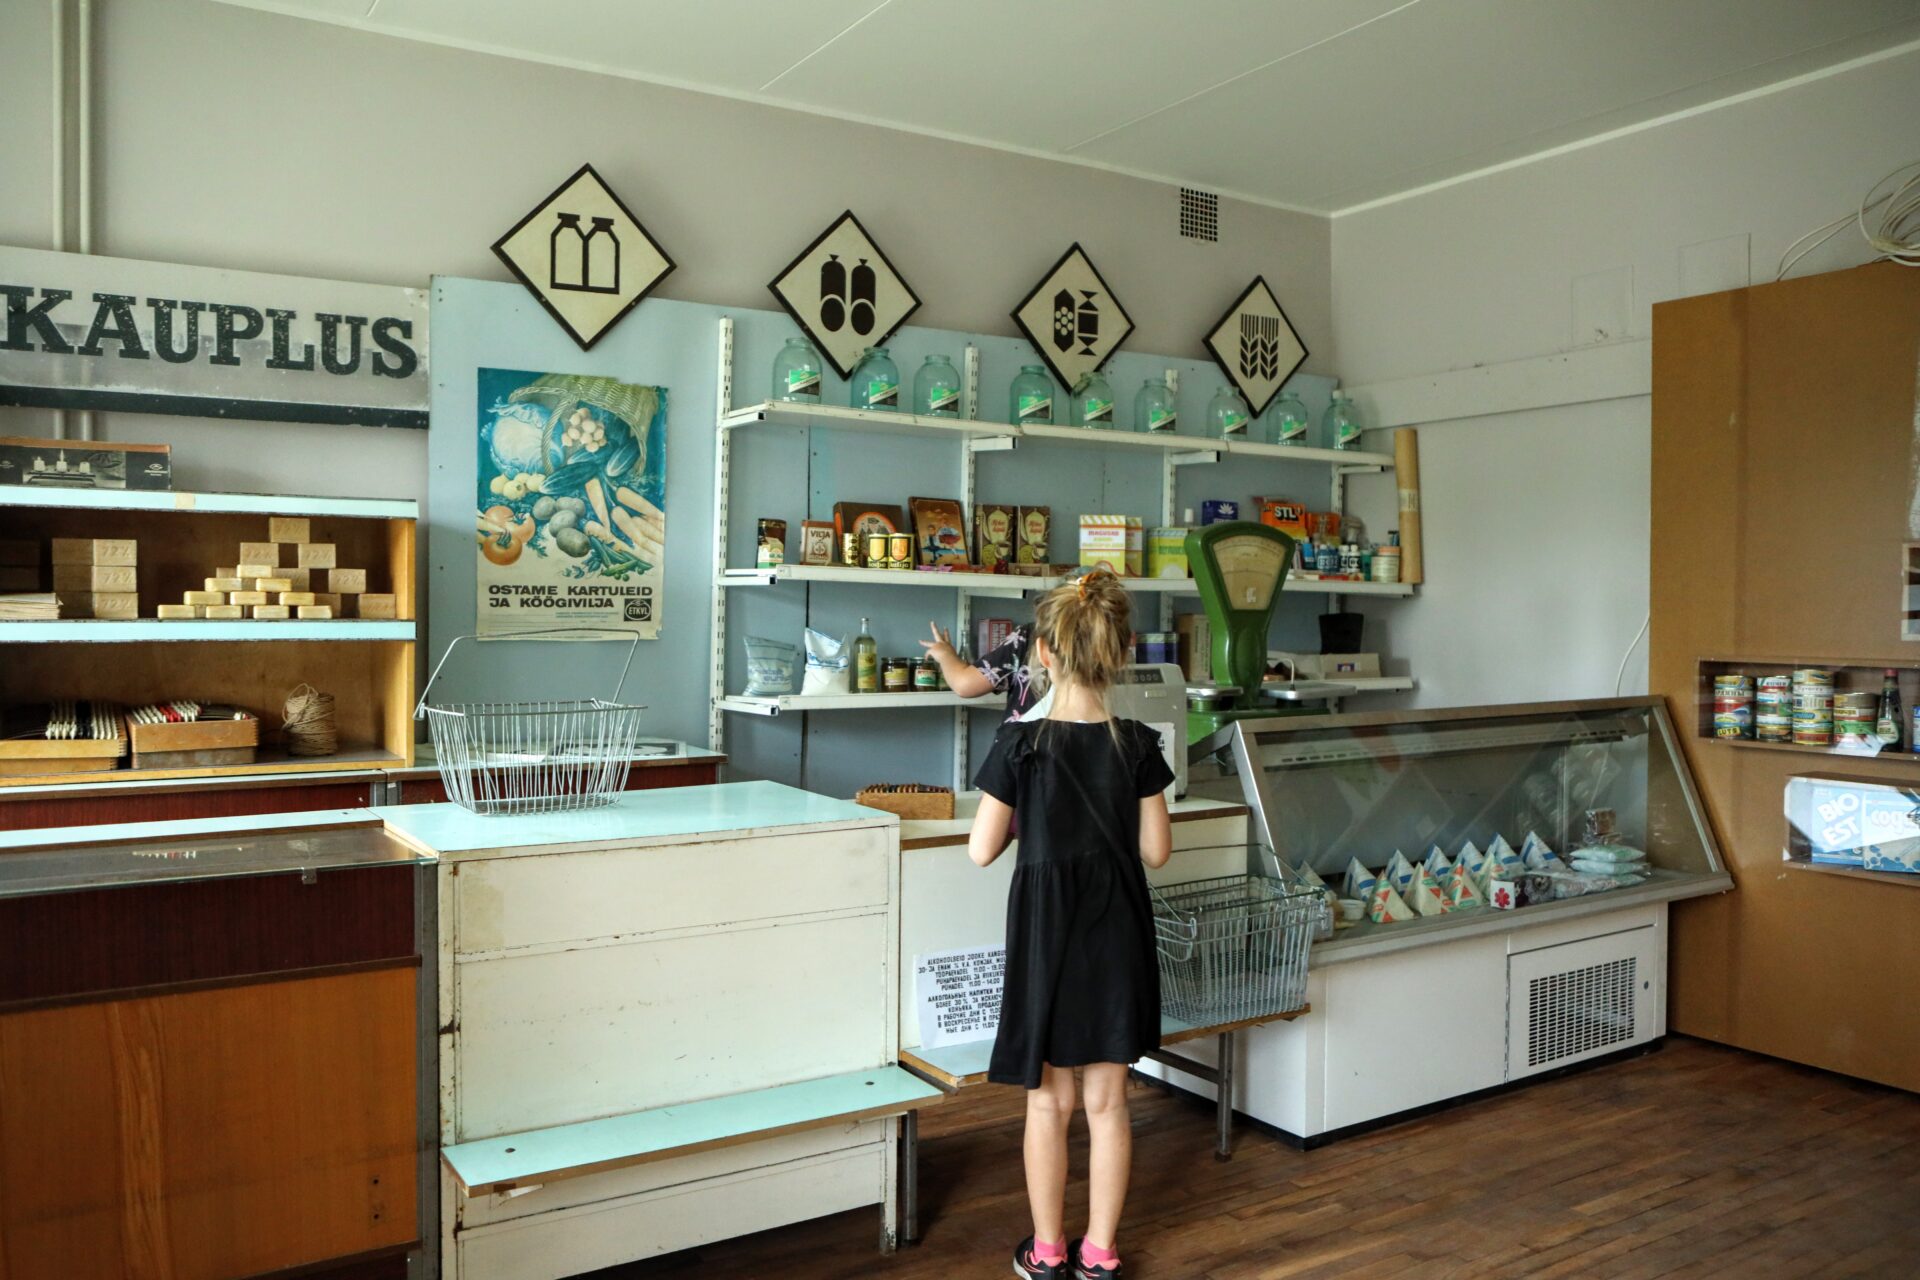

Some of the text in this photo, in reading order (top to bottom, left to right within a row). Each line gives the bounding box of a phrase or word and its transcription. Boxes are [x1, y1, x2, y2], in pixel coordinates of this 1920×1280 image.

[0, 285, 418, 379] KAUPLUS
[810, 530, 831, 540] VILJA
[488, 585, 653, 596] OSTAME KARTULEID
[490, 596, 614, 608] JA KÖÖGIVILJA
[1817, 792, 1859, 823] BIO
[1822, 816, 1860, 846] EST
